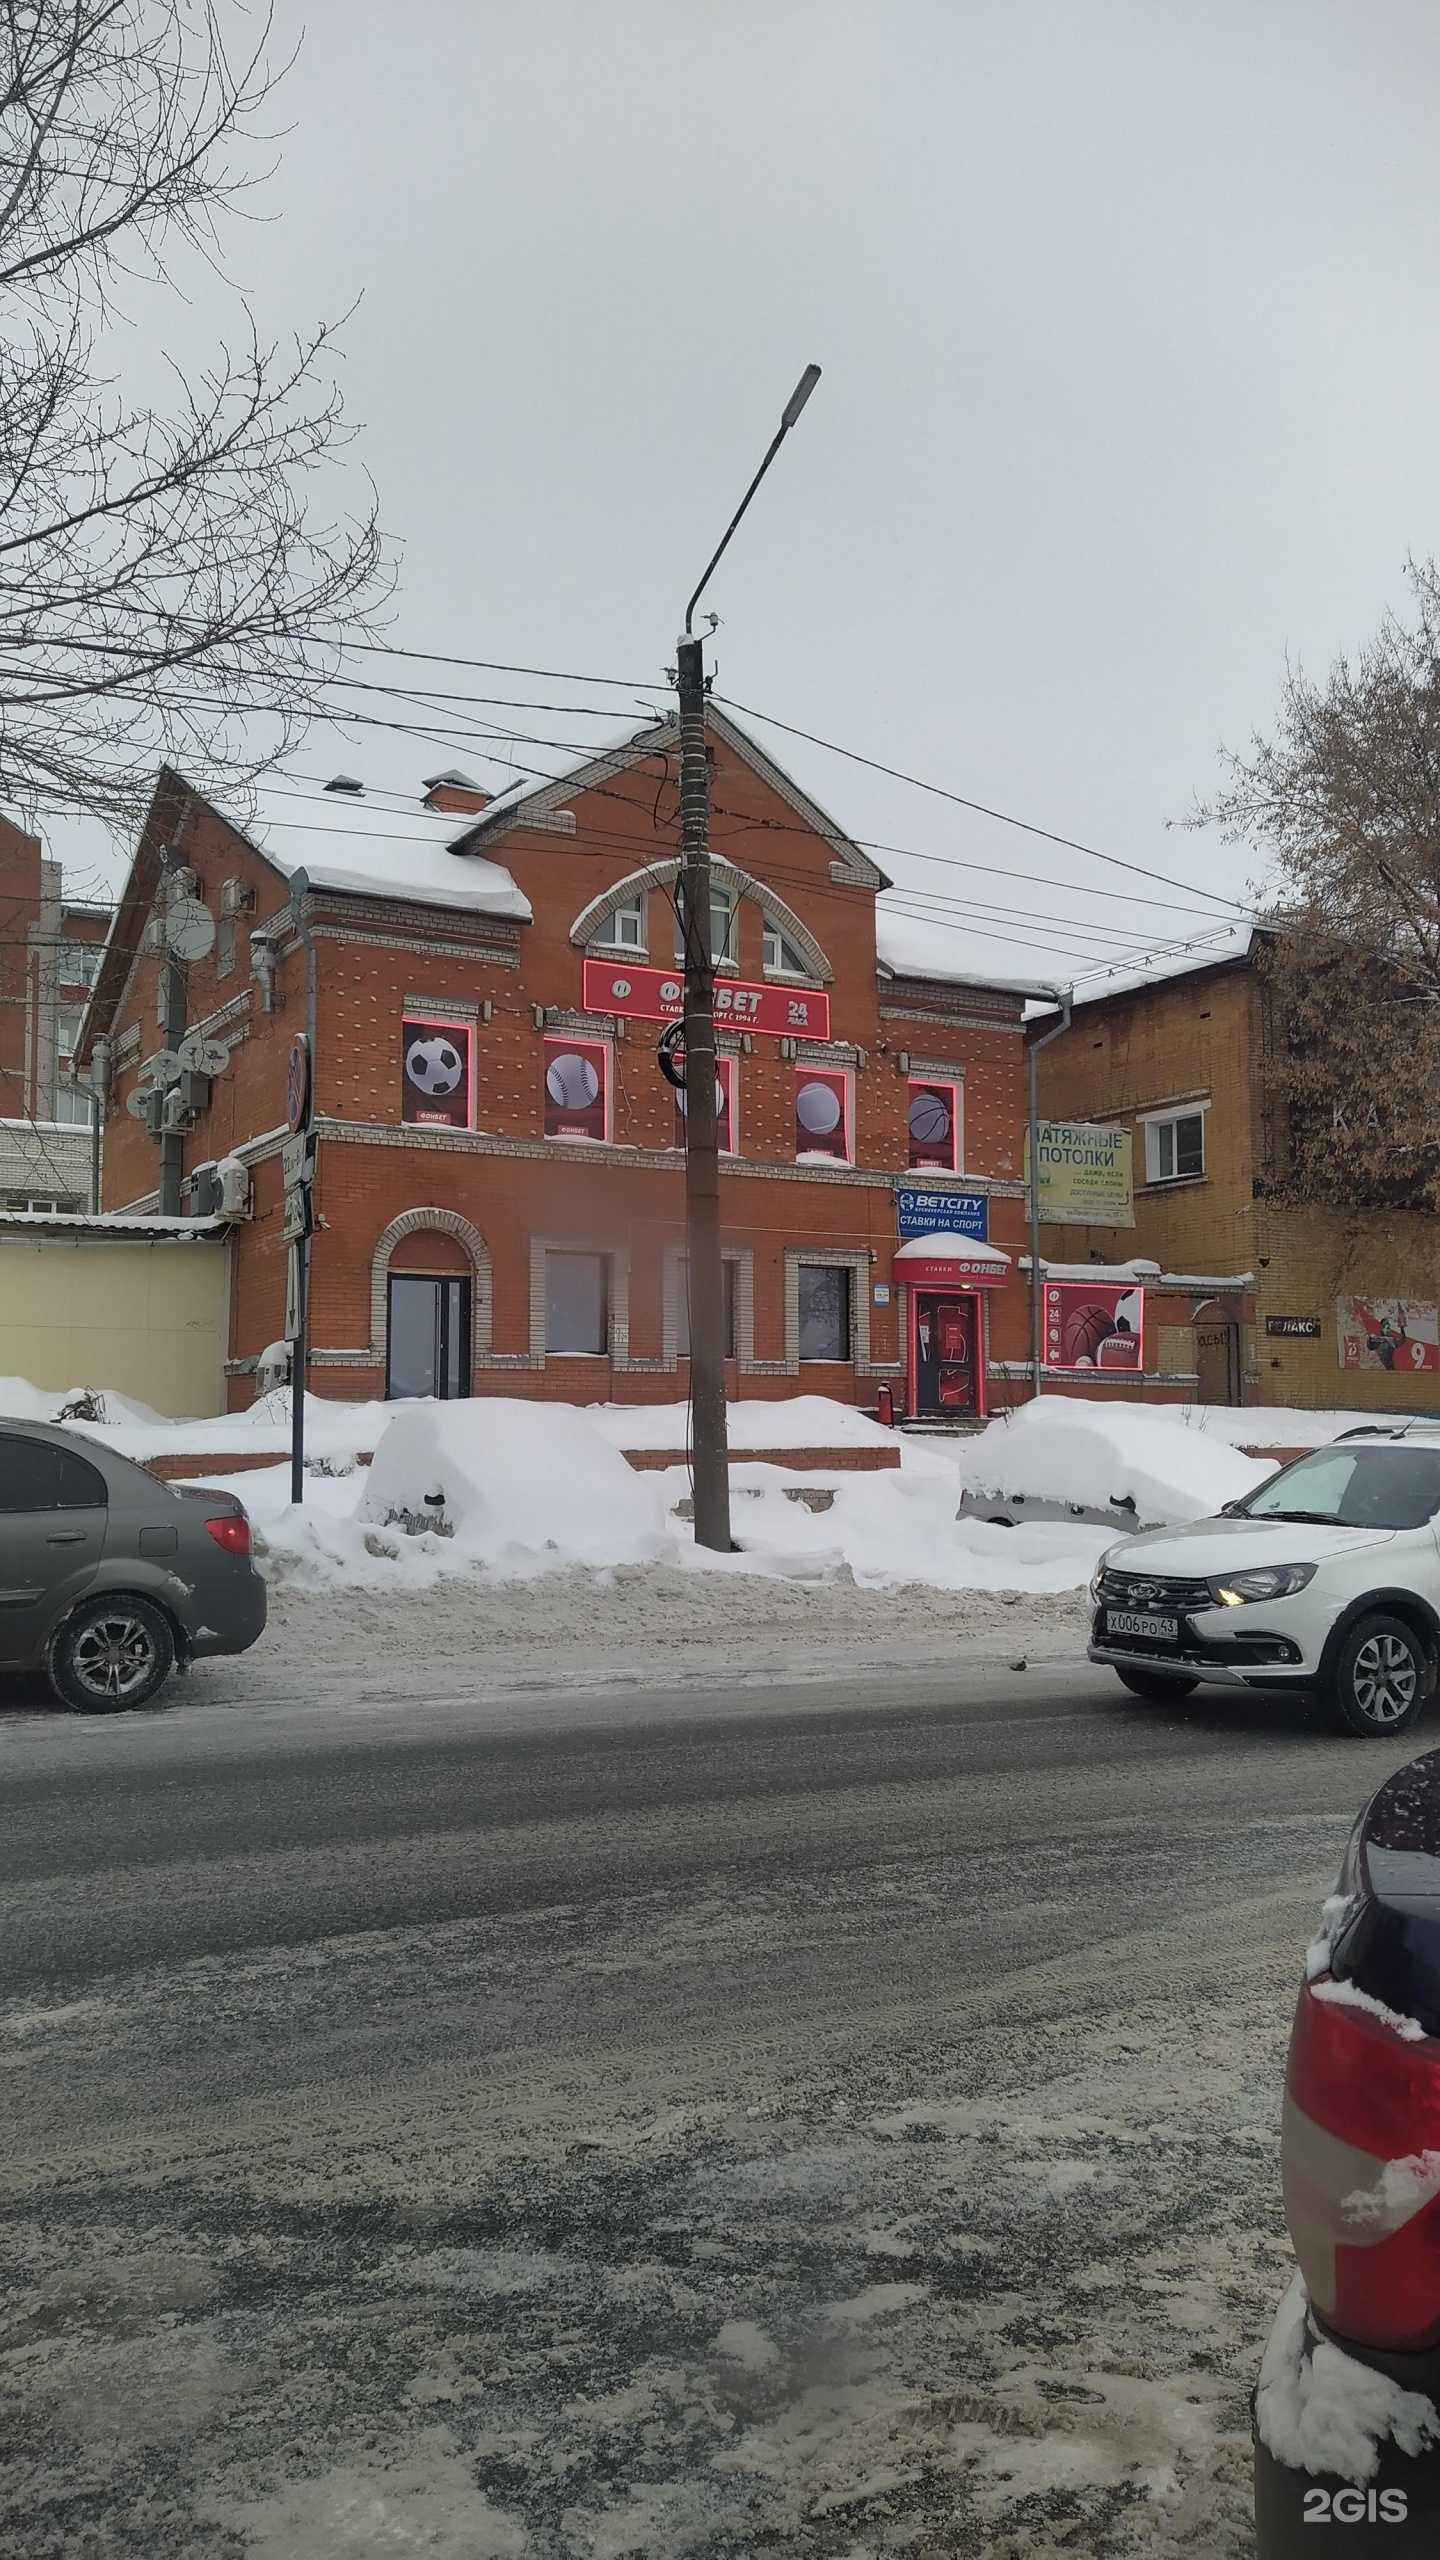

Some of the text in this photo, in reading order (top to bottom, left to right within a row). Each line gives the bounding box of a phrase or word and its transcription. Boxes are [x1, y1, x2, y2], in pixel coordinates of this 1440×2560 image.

[660, 1004, 684, 1014] СТАВК
[1039, 1146, 1115, 1167] ПОТОЛКИ
[916, 1195, 983, 1210] BETCITY
[900, 1215, 984, 1230] СТАВКИ НА СПОРТ
[959, 1263, 1008, 1275] ФОНБЕТ
[1411, 1342, 1426, 1369] 9
[1160, 1619, 1174, 1632] 43
